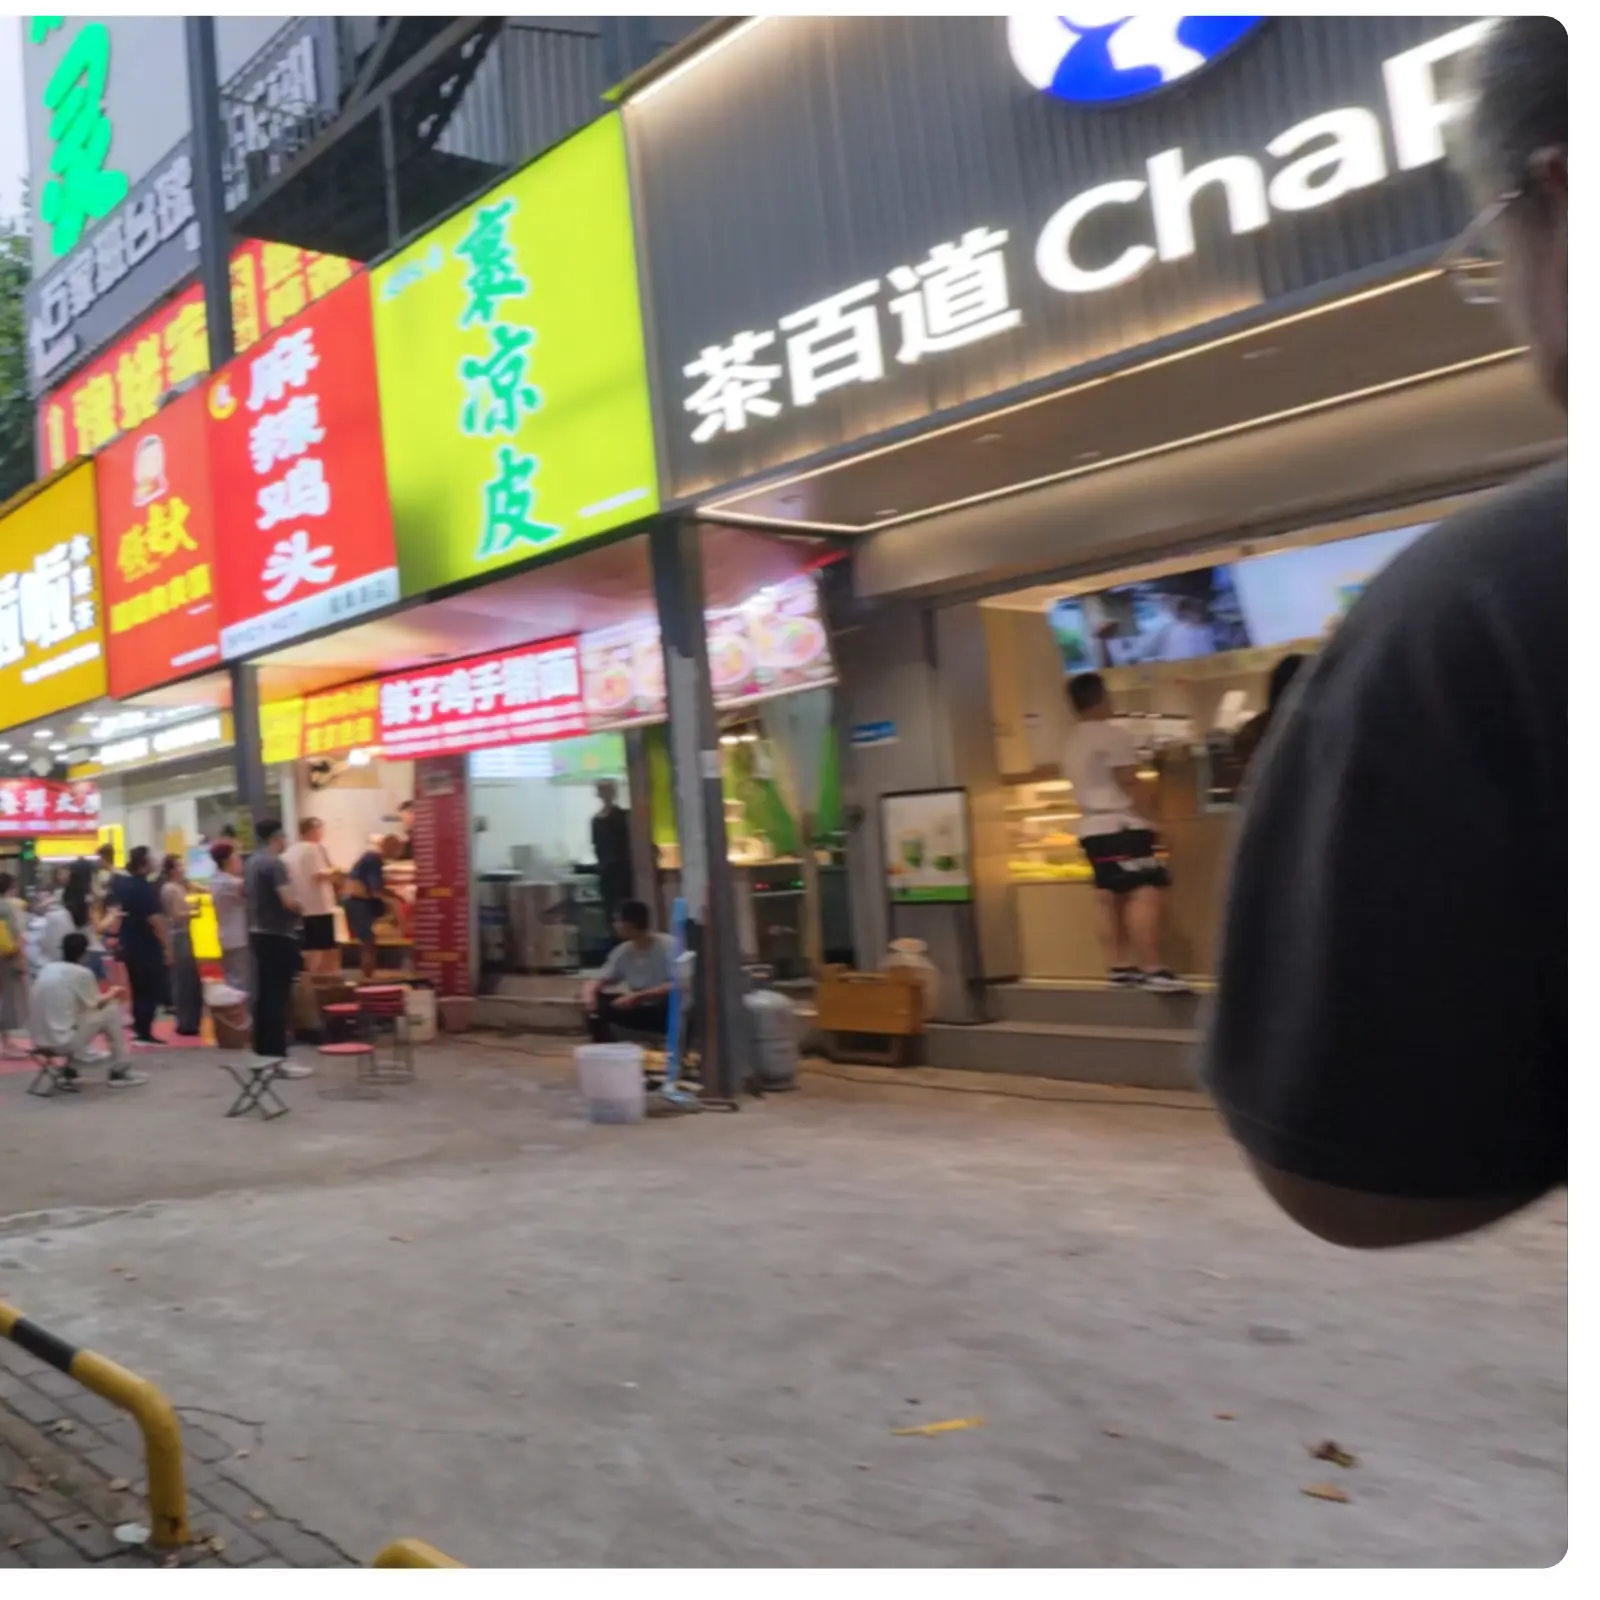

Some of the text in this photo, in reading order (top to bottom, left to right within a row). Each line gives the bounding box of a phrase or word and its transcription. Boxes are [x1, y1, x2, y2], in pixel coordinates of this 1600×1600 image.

[681, 226, 1023, 444] 茶百道
[247, 326, 337, 602] 麻辣鸡头
